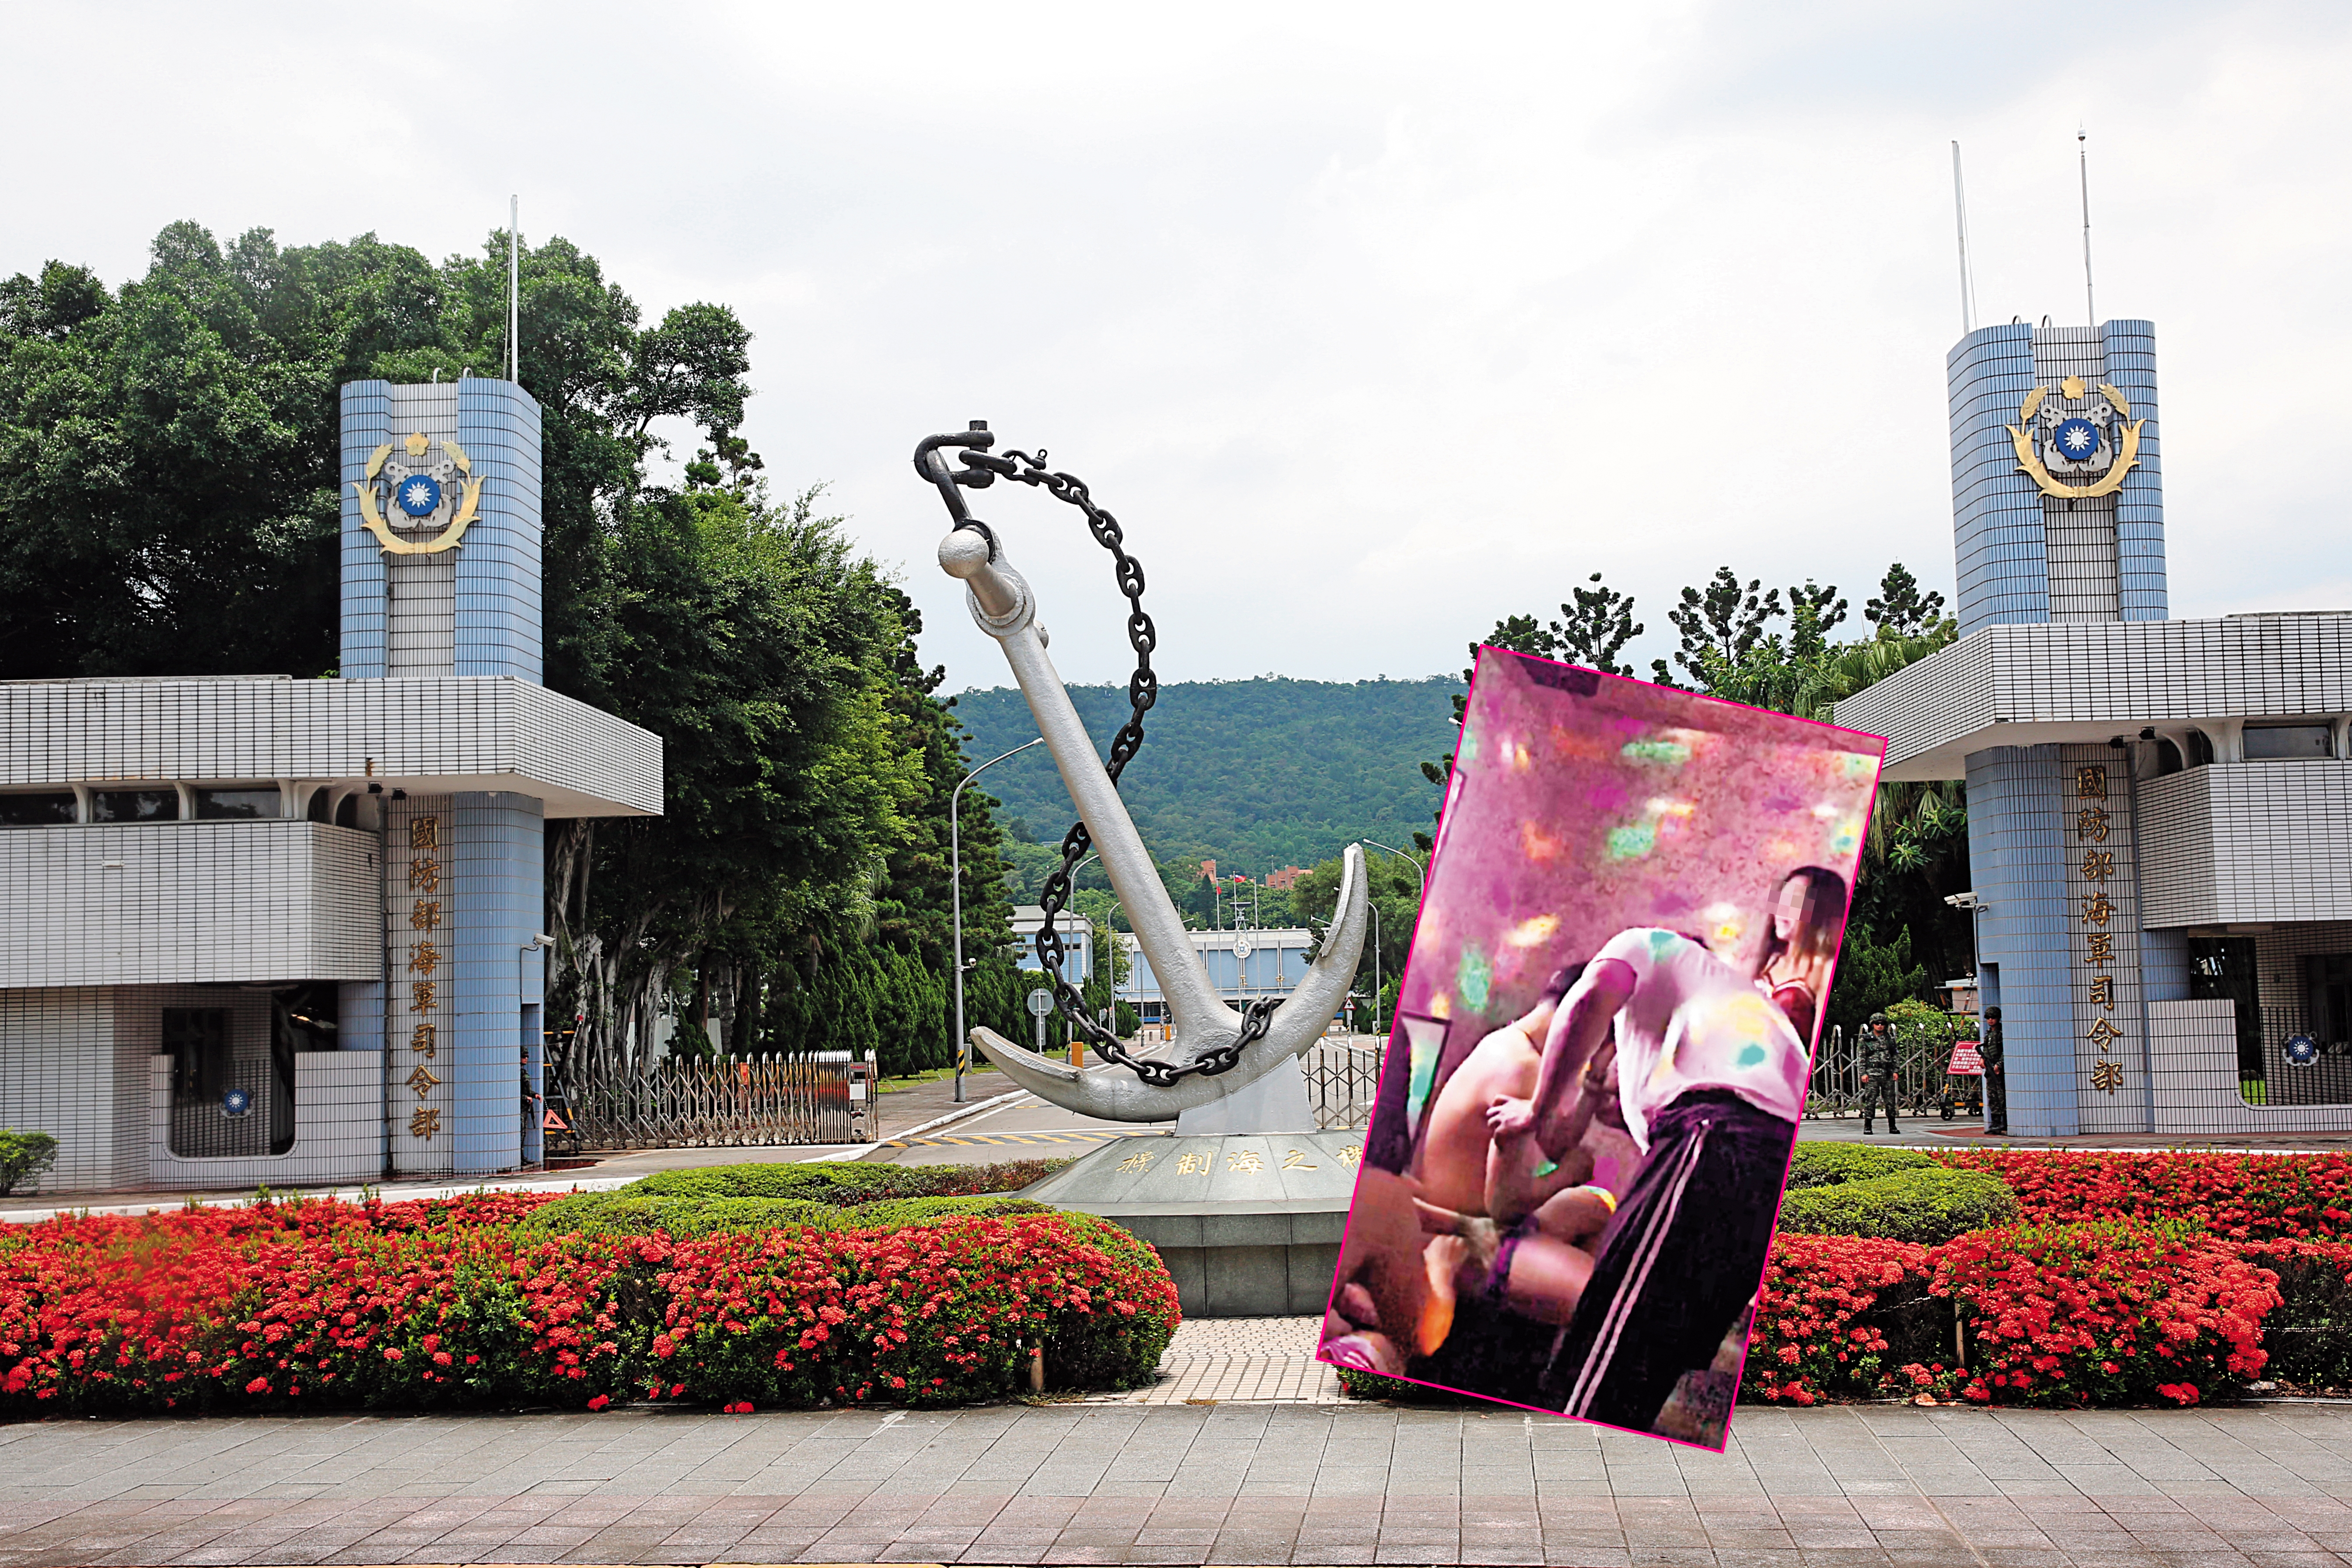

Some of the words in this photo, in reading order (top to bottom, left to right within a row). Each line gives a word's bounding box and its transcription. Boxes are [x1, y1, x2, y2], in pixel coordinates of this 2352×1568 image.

[405, 817, 441, 1140] 國防部海軍司令部
[2076, 765, 2123, 1095] 國防部海軍司令部
